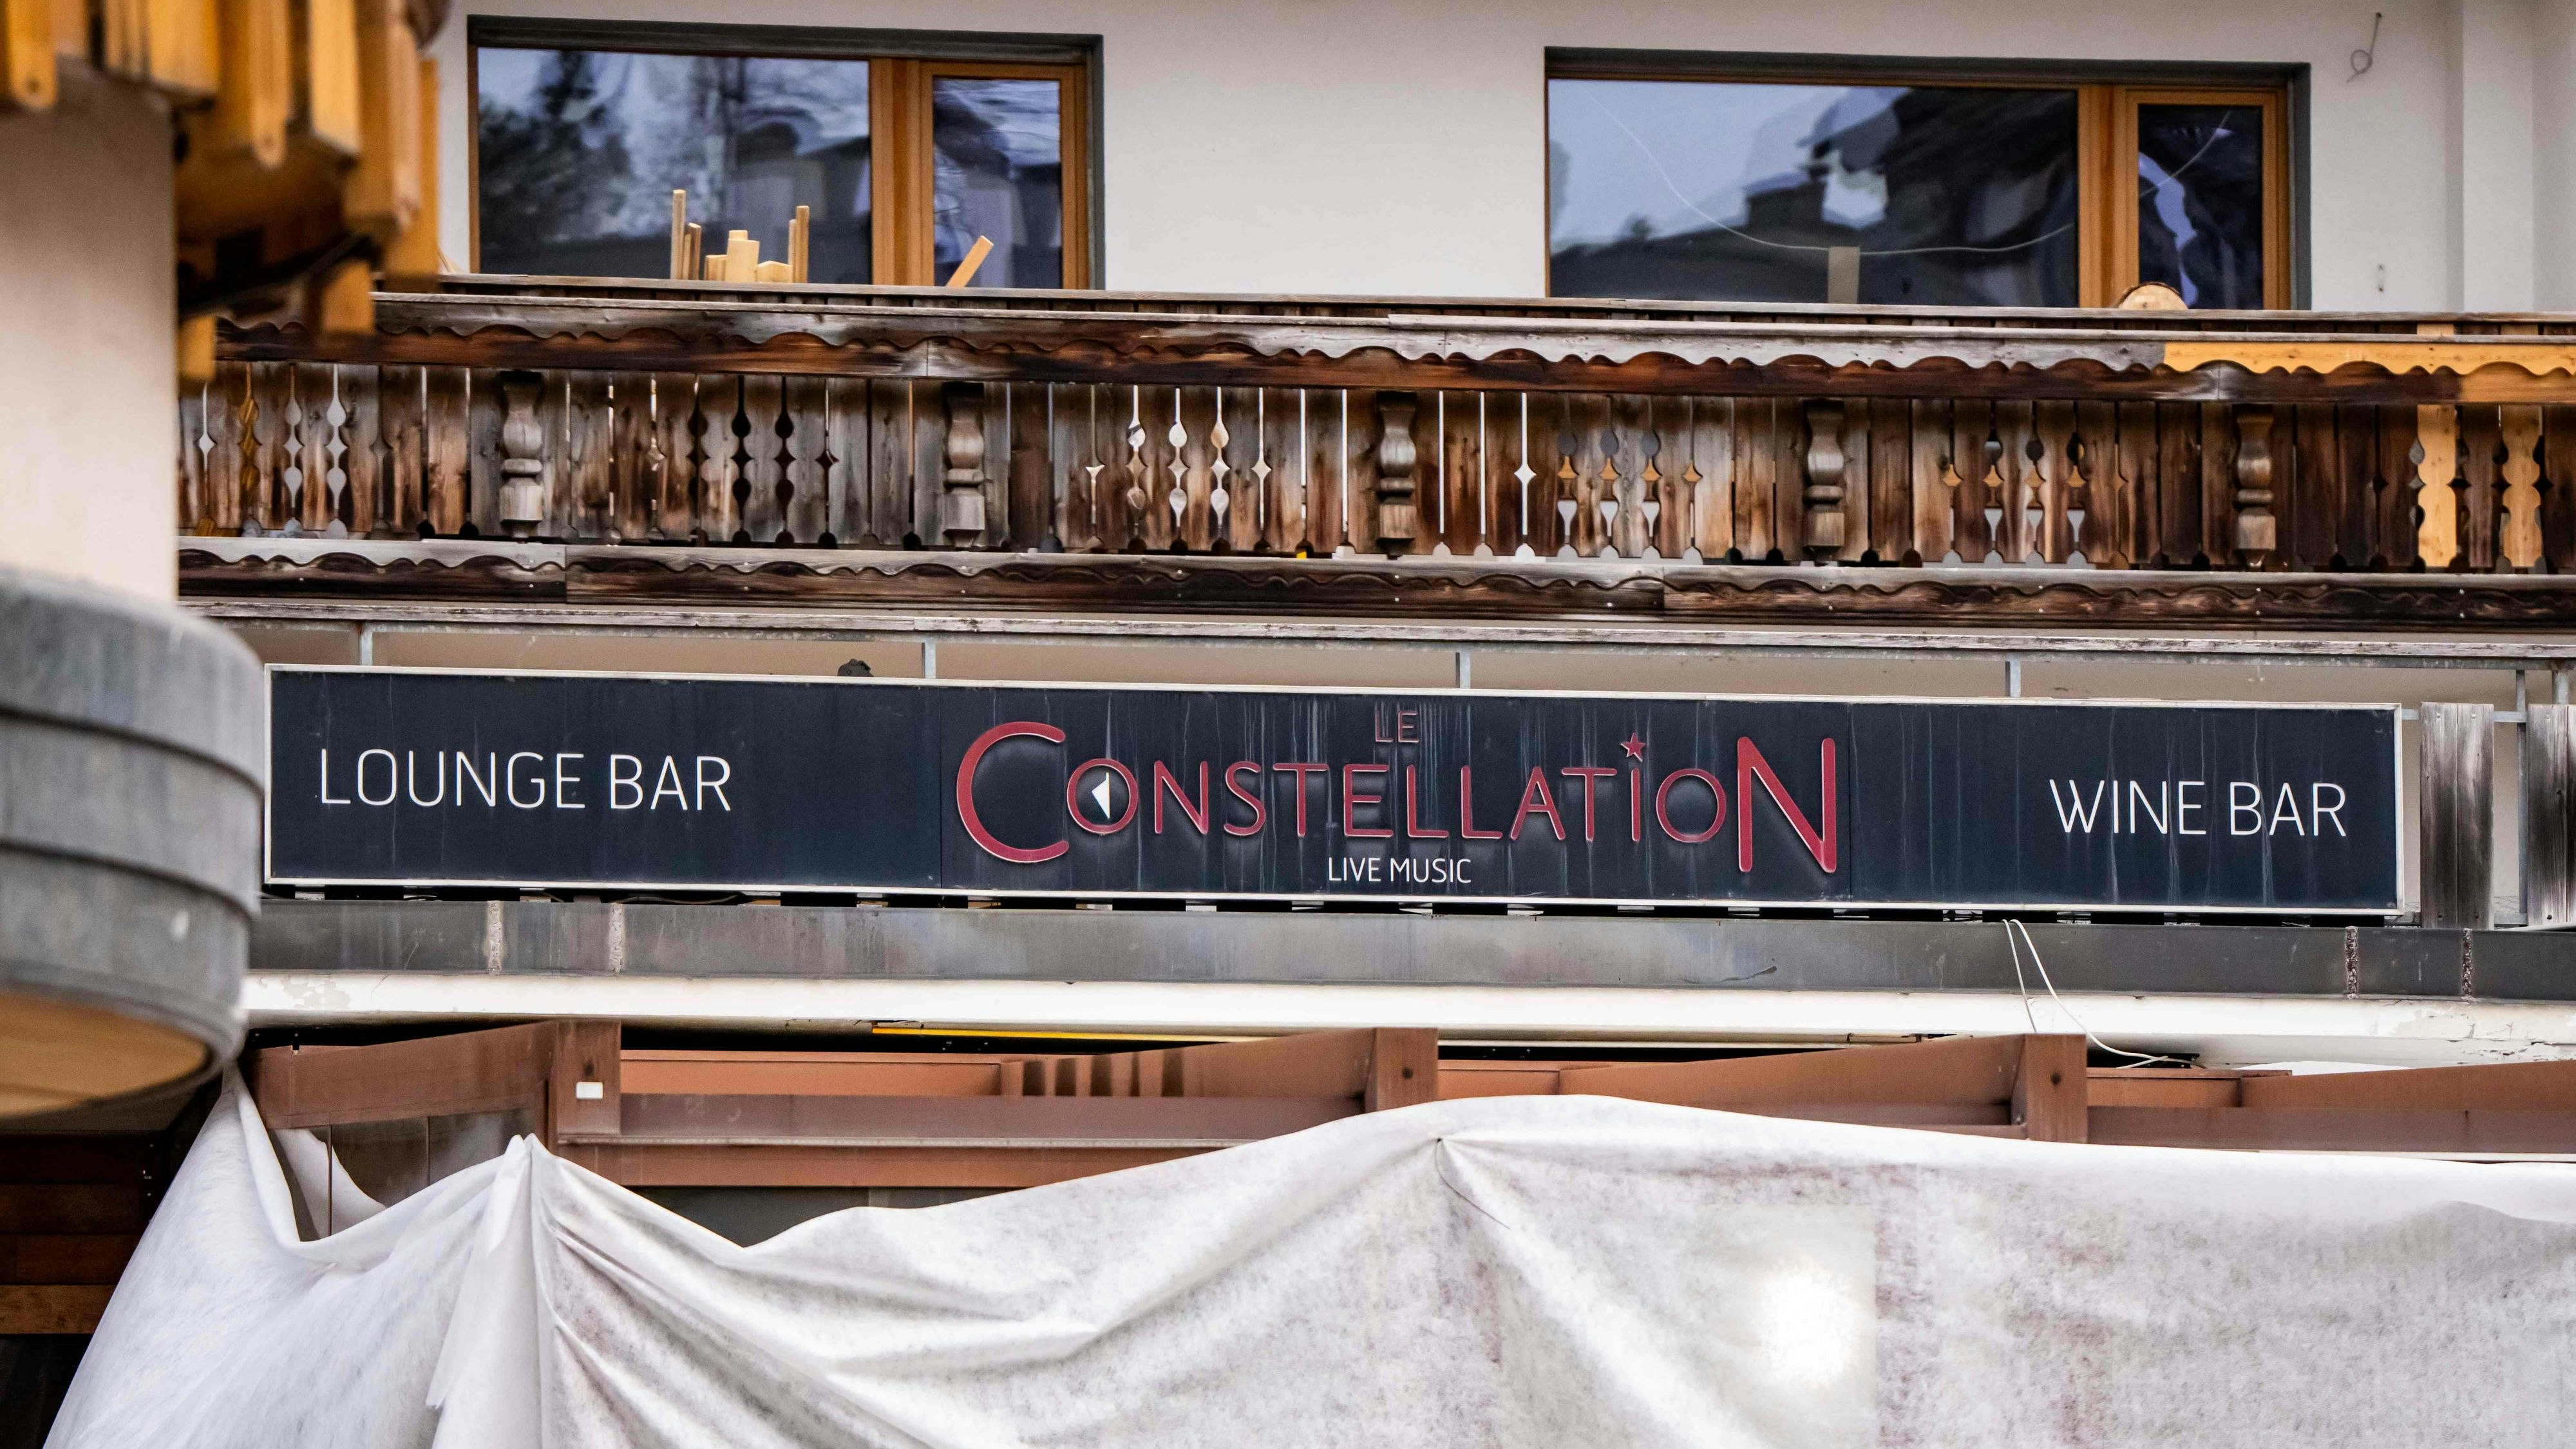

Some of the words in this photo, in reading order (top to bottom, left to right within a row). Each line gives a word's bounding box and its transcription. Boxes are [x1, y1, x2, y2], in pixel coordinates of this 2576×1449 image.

[1374, 710, 1420, 743] LE
[320, 748, 585, 809] LOUNGE
[609, 753, 732, 811] BAR
[2049, 779, 2207, 835] WINE
[2230, 781, 2347, 837] BAR
[1327, 857, 1381, 882] LIVE
[1389, 857, 1472, 884] MUSIC
